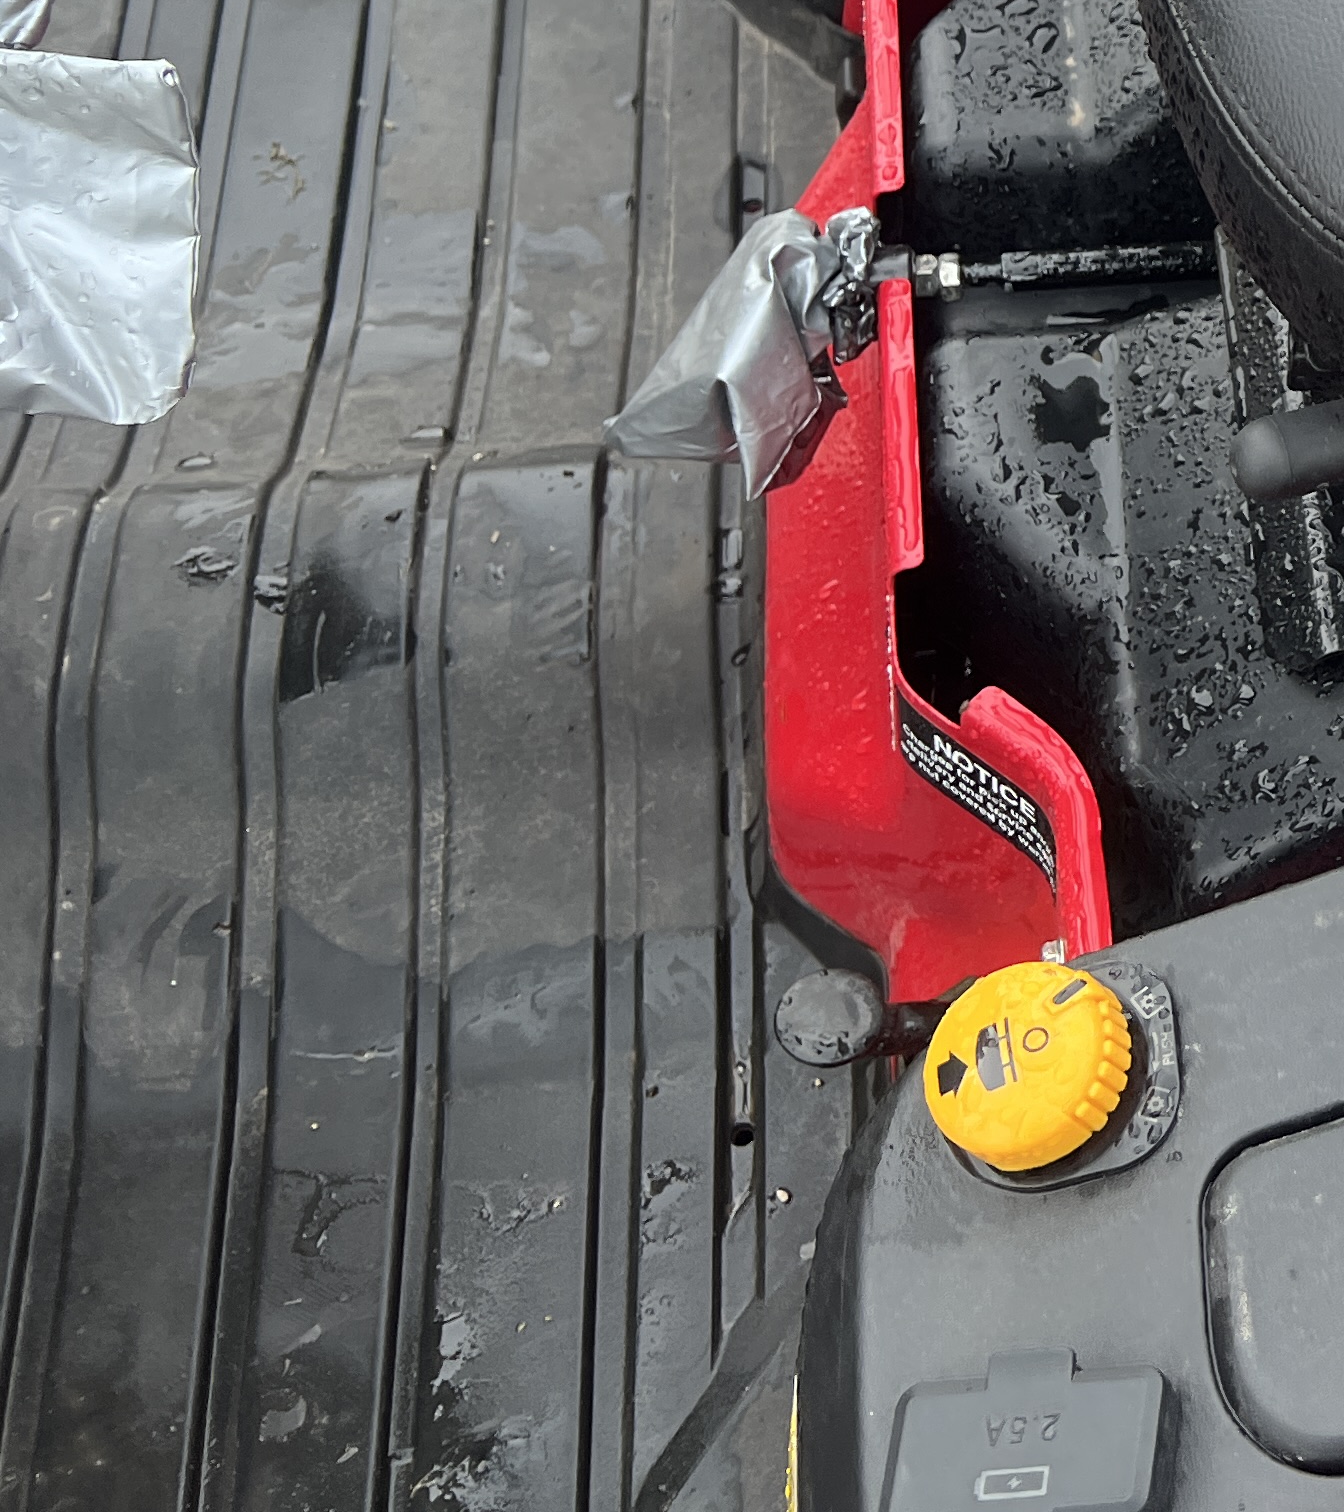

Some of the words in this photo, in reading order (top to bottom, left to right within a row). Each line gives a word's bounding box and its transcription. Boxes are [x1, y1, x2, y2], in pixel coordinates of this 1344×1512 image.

[933, 734, 1036, 823] NOTICE
[998, 819, 1015, 837] by
[986, 1413, 1061, 1447] 2.5A
